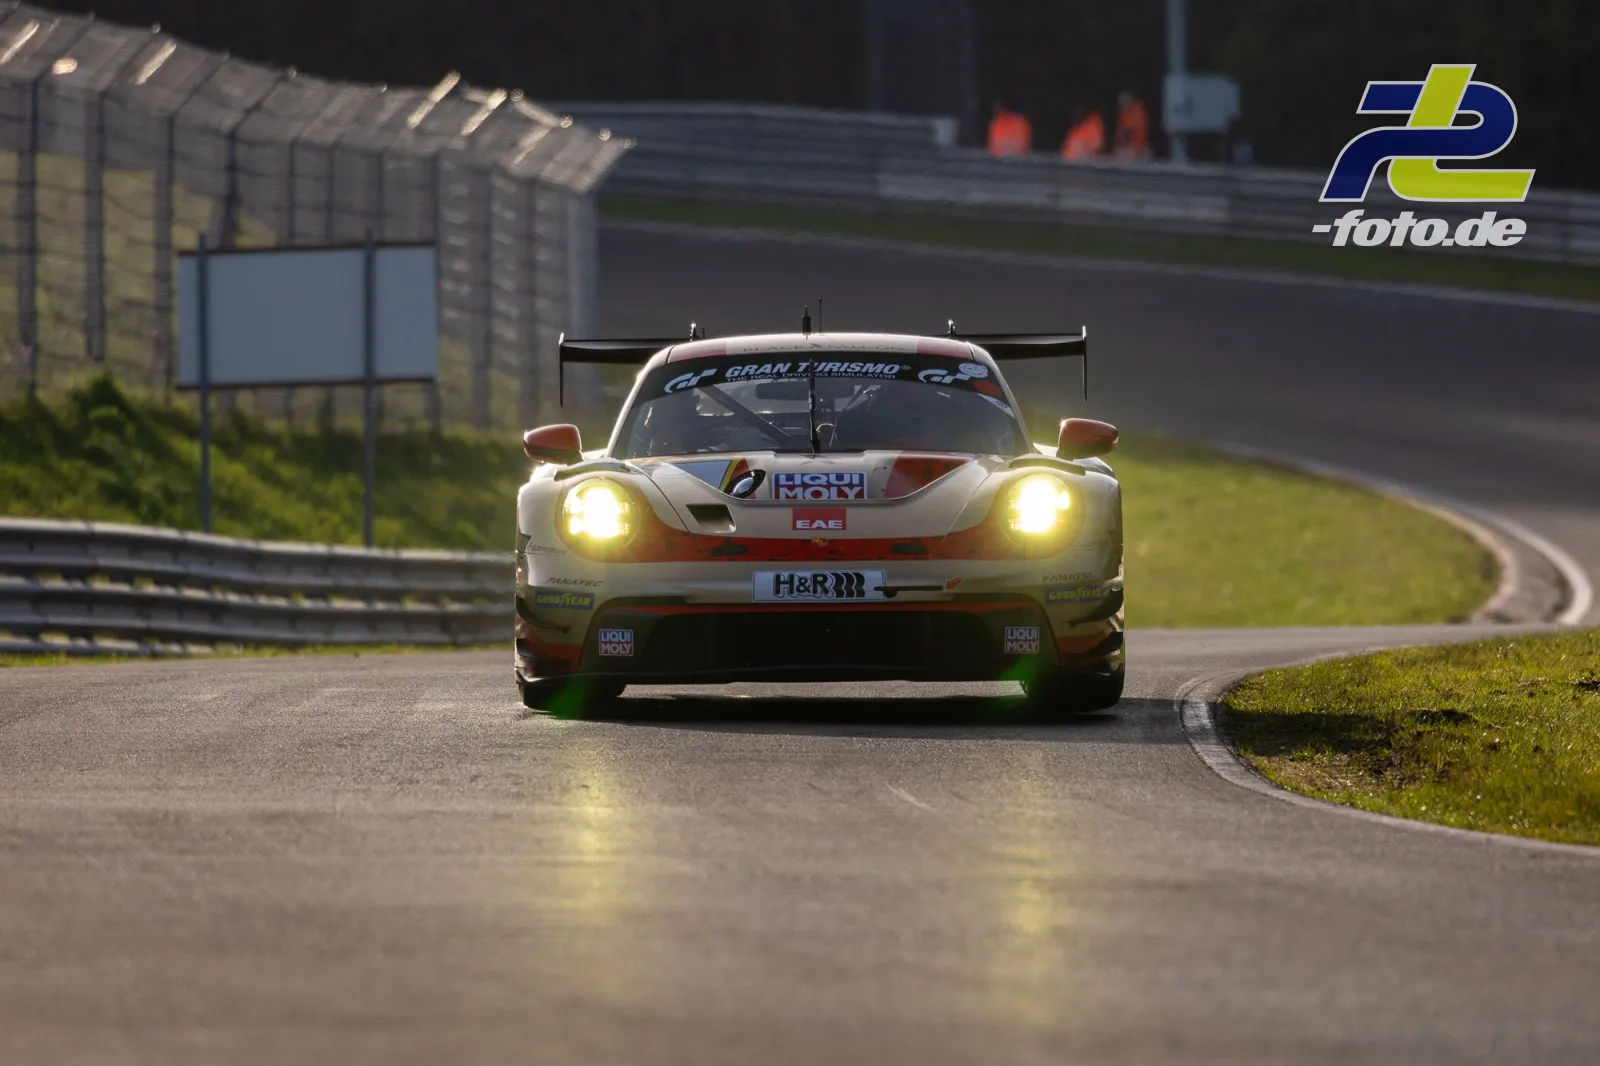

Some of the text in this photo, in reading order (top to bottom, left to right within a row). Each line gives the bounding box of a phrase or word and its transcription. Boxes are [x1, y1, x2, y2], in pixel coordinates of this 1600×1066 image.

[725, 362, 792, 378] GRAN
[831, 371, 896, 379] SIMULATOR
[778, 473, 860, 485] LIQUI
[778, 486, 862, 500] MOLY
[795, 519, 843, 529] EAE
[545, 577, 603, 587] FANATEC
[1041, 571, 1096, 583] FANATEC
[774, 572, 832, 598] H&R
[537, 592, 592, 606] GOODYEAR
[601, 631, 631, 642] LIQUI
[1007, 629, 1037, 640] LIQUI
[601, 643, 632, 654] MOLY
[1006, 641, 1038, 652] MOLY
